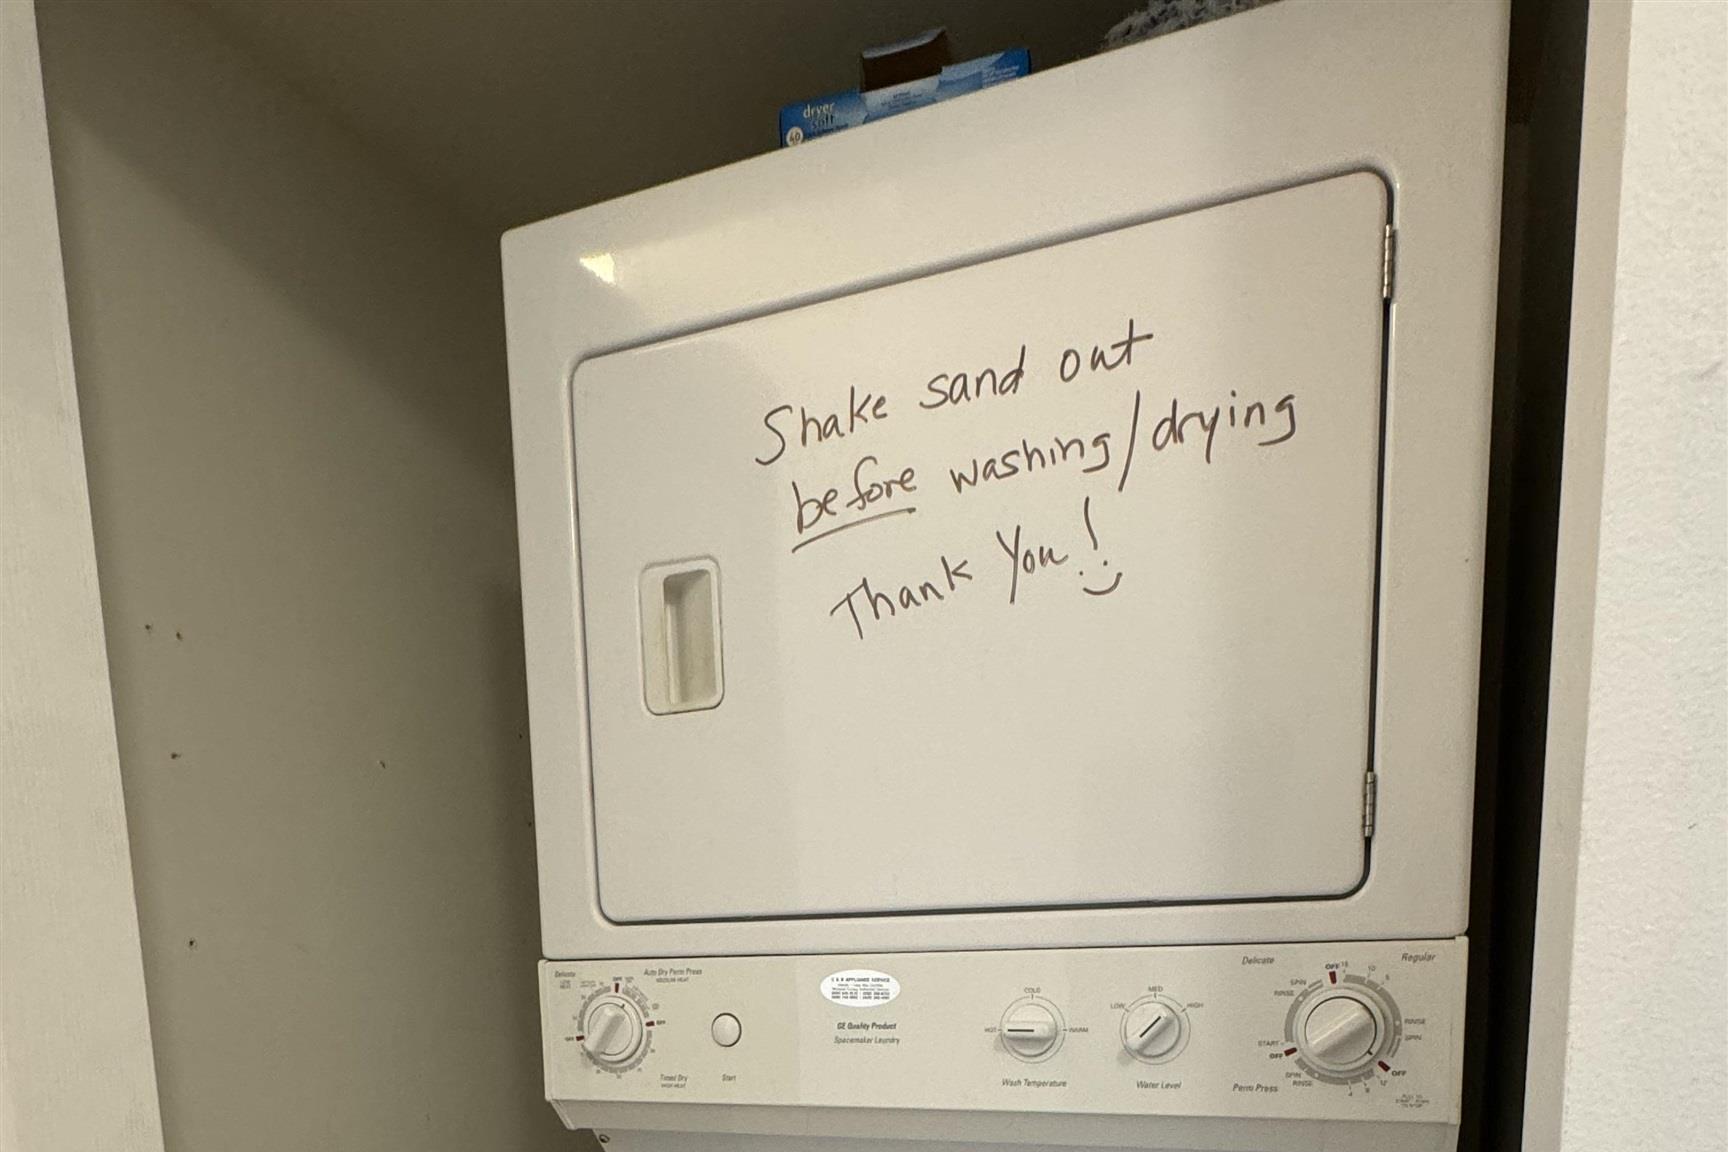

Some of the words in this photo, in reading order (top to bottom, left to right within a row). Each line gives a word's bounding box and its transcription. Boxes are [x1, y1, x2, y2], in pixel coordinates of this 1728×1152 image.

[803, 102, 835, 119] dryer
[755, 385, 888, 465] Shake
[919, 344, 1026, 409] sand
[1059, 318, 1154, 382] out
[791, 455, 917, 534] before
[829, 555, 974, 640] Thank
[1242, 956, 1275, 966] Delicate
[1401, 952, 1437, 963] Regular
[837, 1022, 847, 1030] GE
[847, 1022, 870, 1031] Quality
[871, 1022, 897, 1030] Product
[834, 1036, 873, 1045] Spacemaker
[874, 1035, 900, 1045] Laundry
[722, 1074, 736, 1082] Start
[1002, 1079, 1022, 1087] Wash
[1023, 1079, 1067, 1088] Temperature
[1136, 1080, 1160, 1089] Water
[1161, 1080, 1182, 1089] Level
[1232, 1084, 1254, 1092] Perm
[1255, 1084, 1278, 1093] Press
